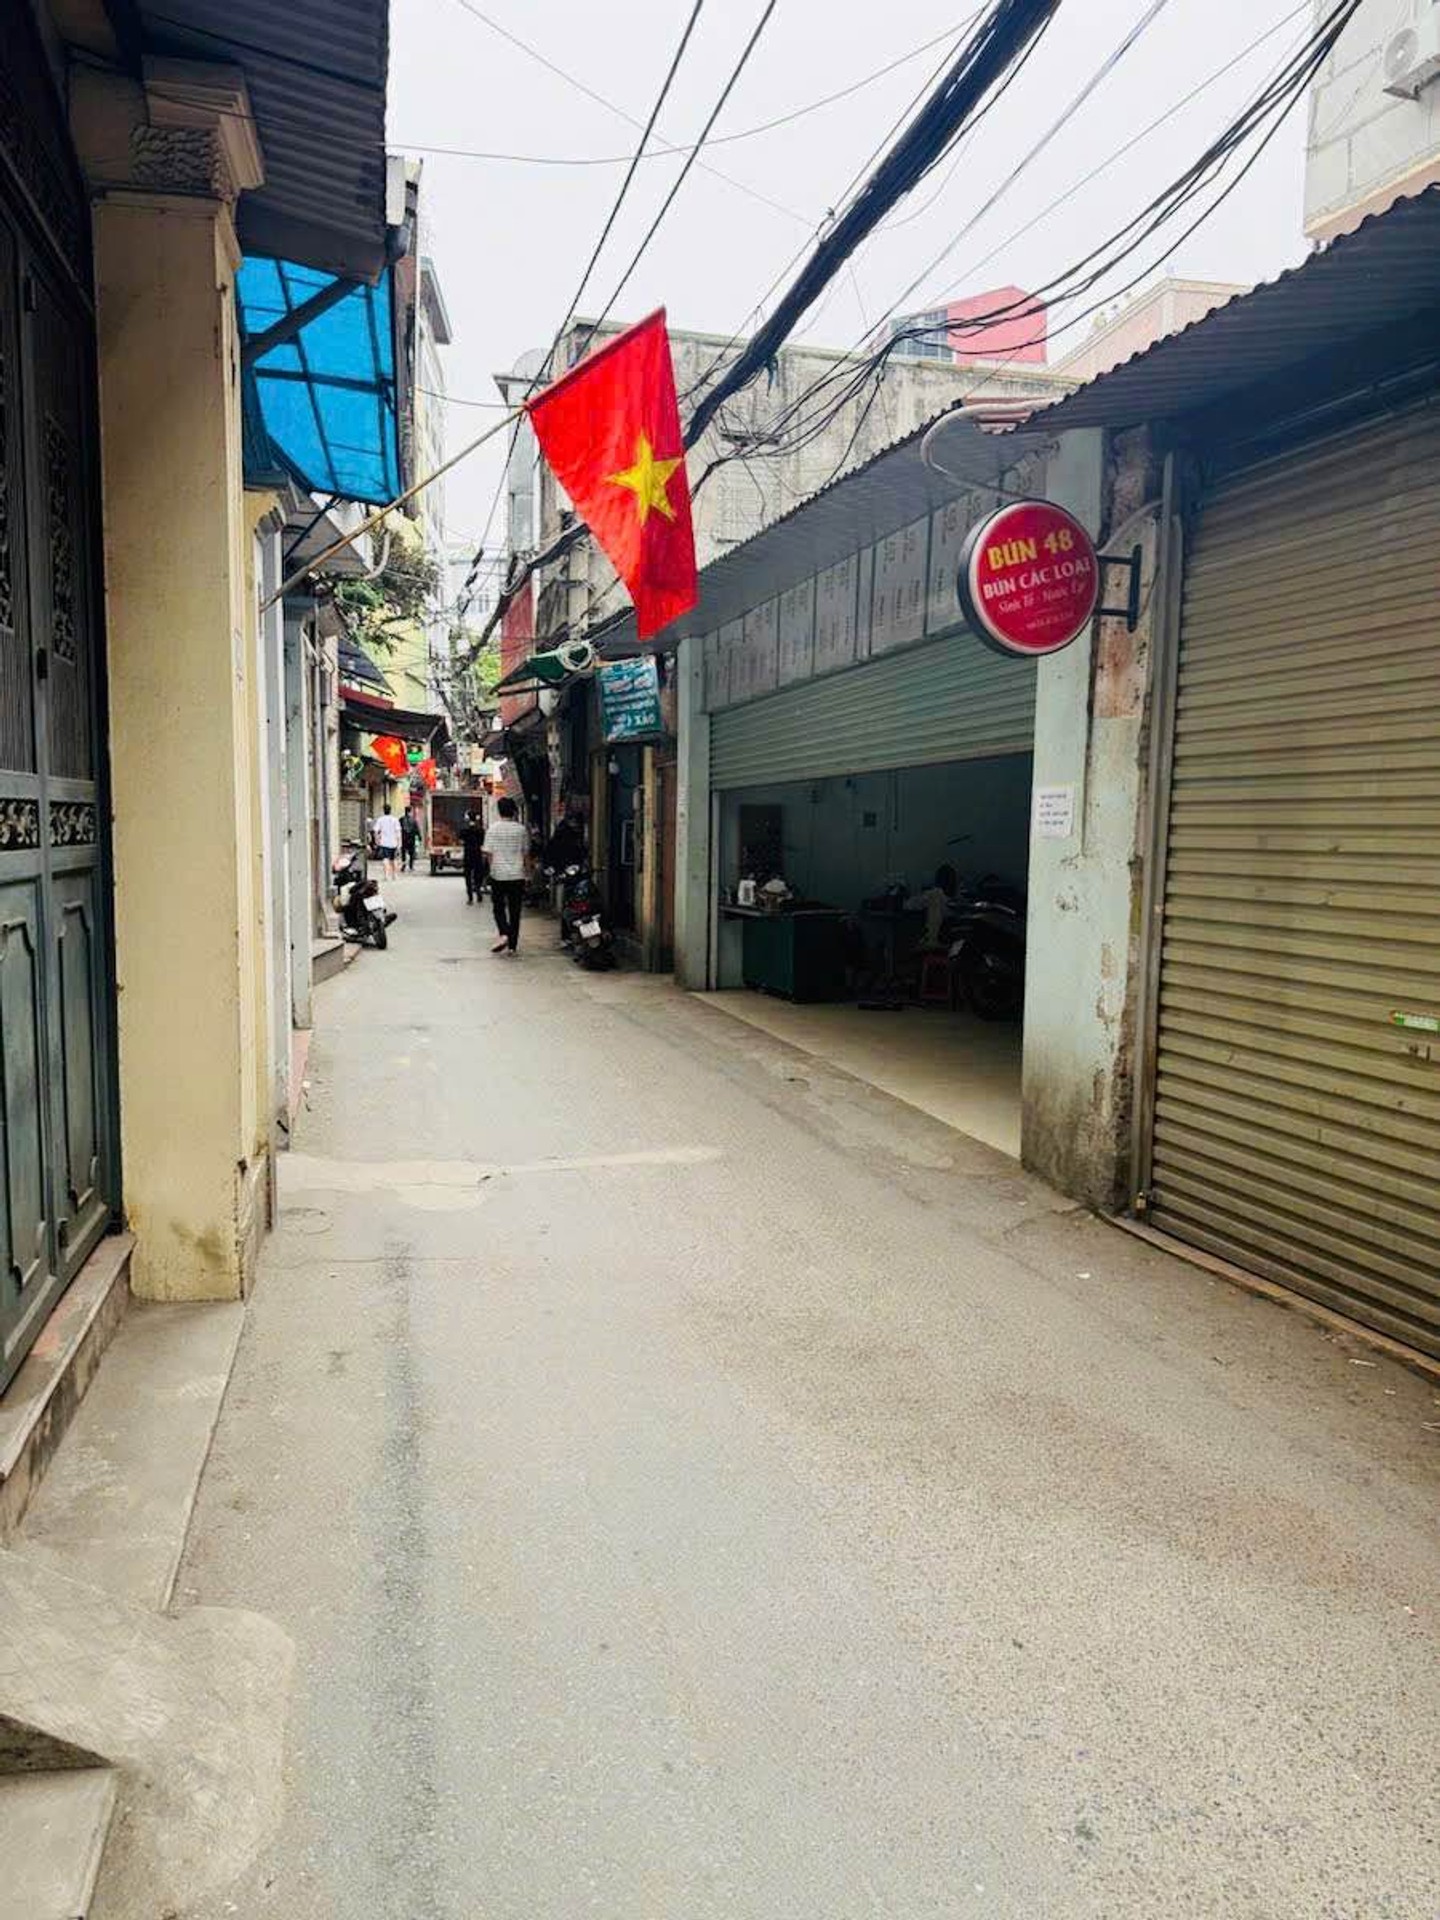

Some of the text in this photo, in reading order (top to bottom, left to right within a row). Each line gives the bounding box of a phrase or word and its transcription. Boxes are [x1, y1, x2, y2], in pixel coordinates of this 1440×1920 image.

[988, 529, 1073, 570] BÚN 48
[983, 579, 1016, 600] BÚN
